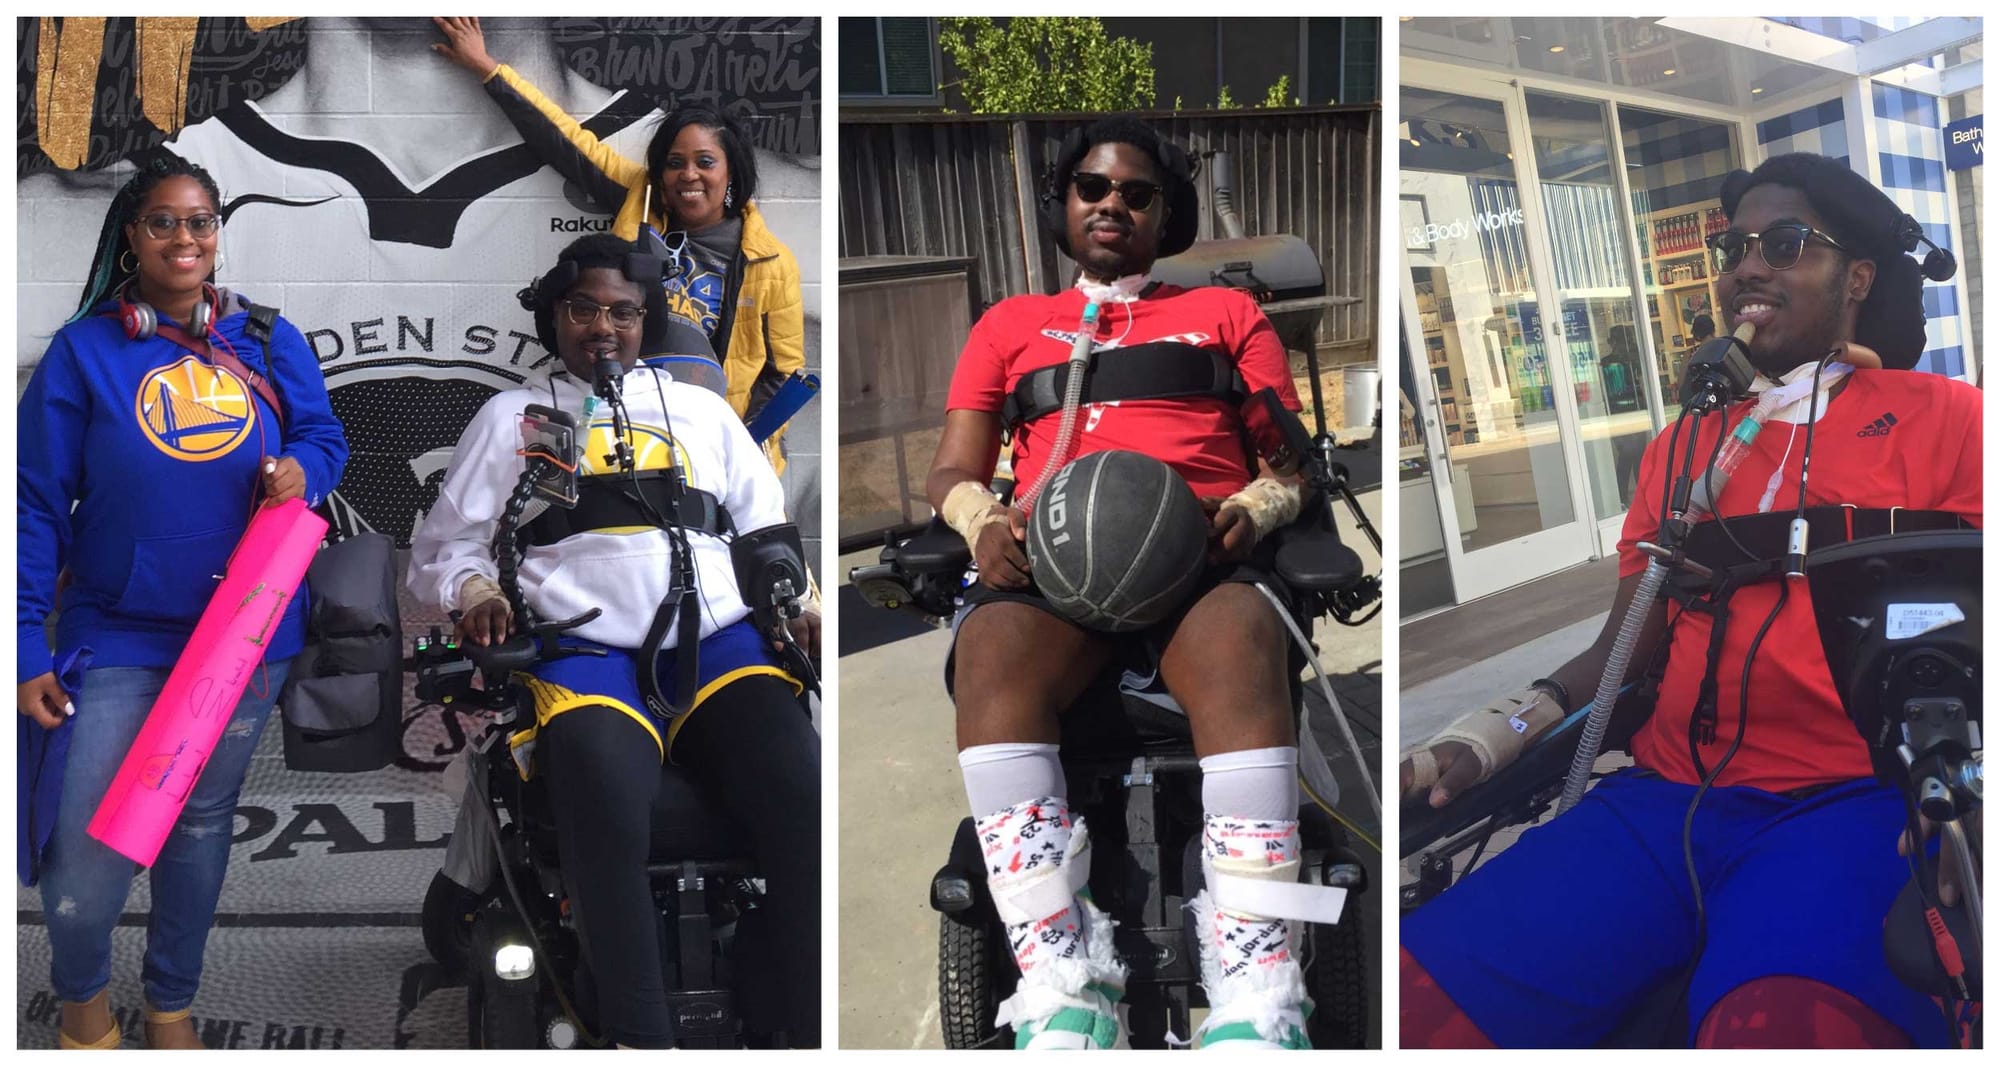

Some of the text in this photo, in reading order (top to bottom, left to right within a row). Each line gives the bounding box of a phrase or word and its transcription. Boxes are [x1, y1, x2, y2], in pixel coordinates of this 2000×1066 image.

[1953, 126, 1983, 145] Bath
[1425, 218, 1469, 242] Body
[1471, 206, 1524, 233] Works
